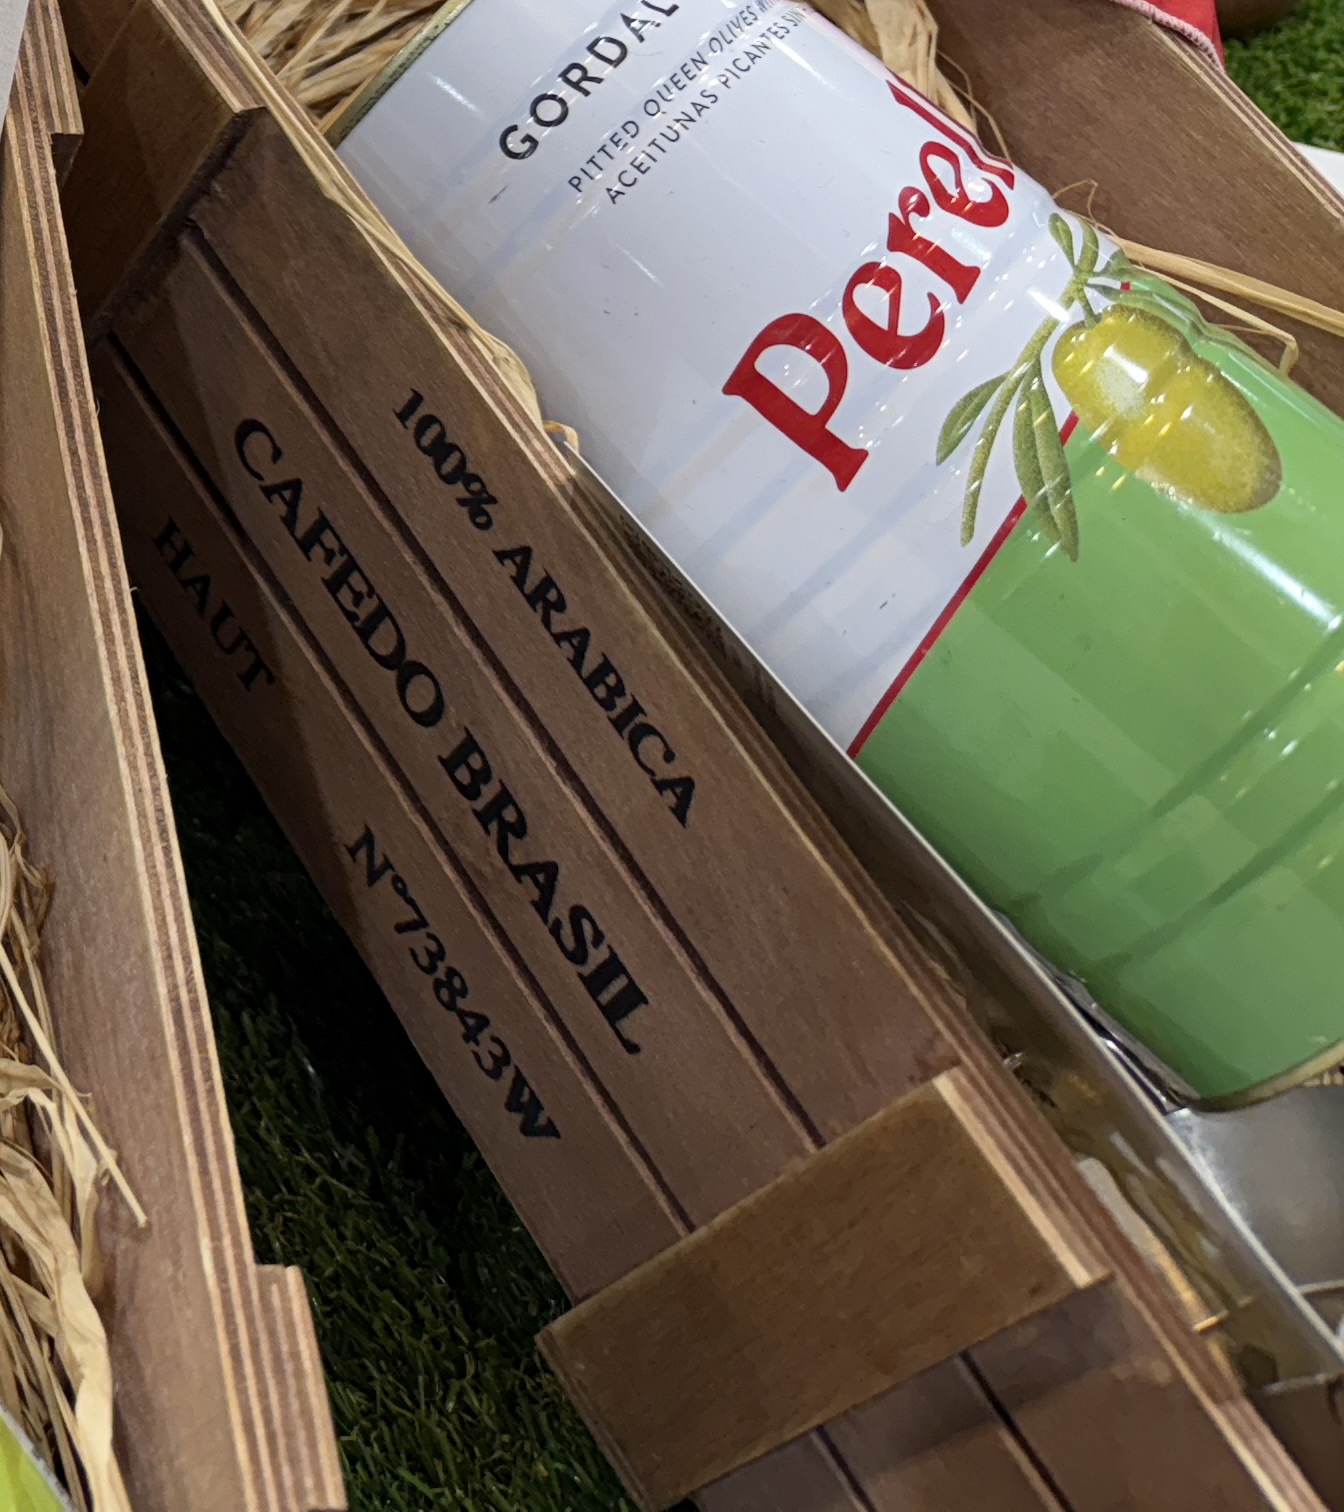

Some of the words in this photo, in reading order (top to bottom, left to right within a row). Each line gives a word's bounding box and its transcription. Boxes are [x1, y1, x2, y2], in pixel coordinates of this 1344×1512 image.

[567, 121, 643, 195] PITTED
[643, 49, 710, 120] QUEEN
[606, 89, 722, 205] ACEITUNAS
[715, 18, 794, 91] PICANTES
[151, 515, 278, 694] HAUT
[393, 389, 501, 532] 100%
[491, 543, 698, 830] ARABICA
[439, 726, 652, 1057] BRASIL
